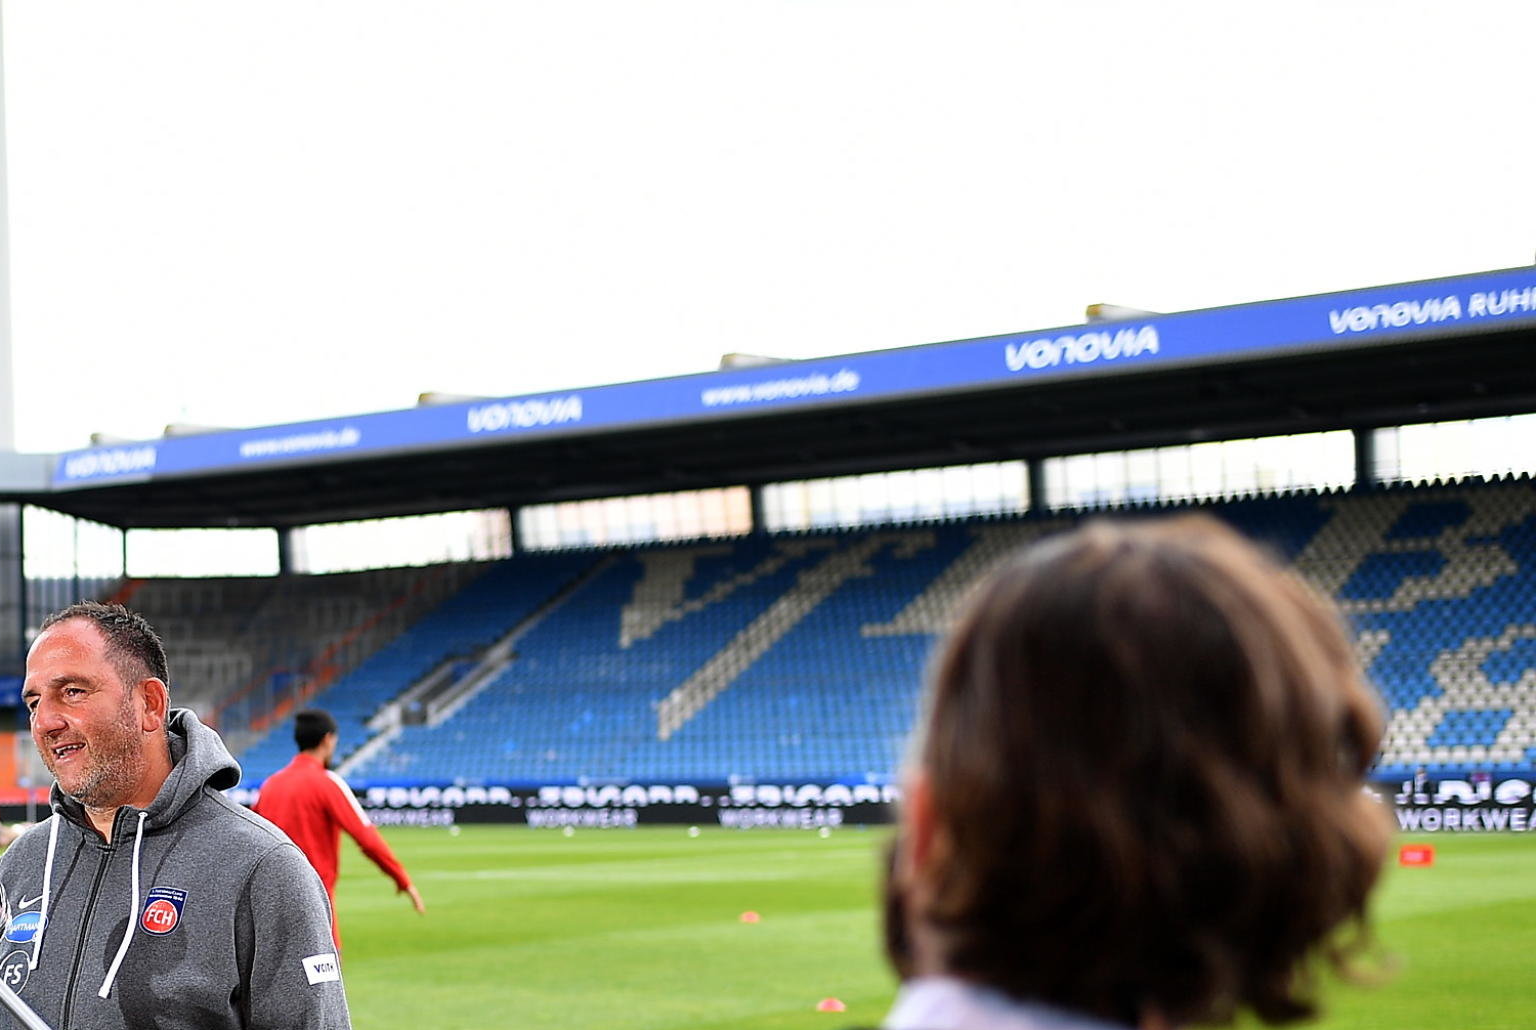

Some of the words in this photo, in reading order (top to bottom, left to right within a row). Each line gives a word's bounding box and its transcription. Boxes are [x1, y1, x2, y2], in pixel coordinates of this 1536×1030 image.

[1468, 286, 1536, 318] RUH
[146, 908, 174, 926] FCH
[4, 964, 24, 985] FS
